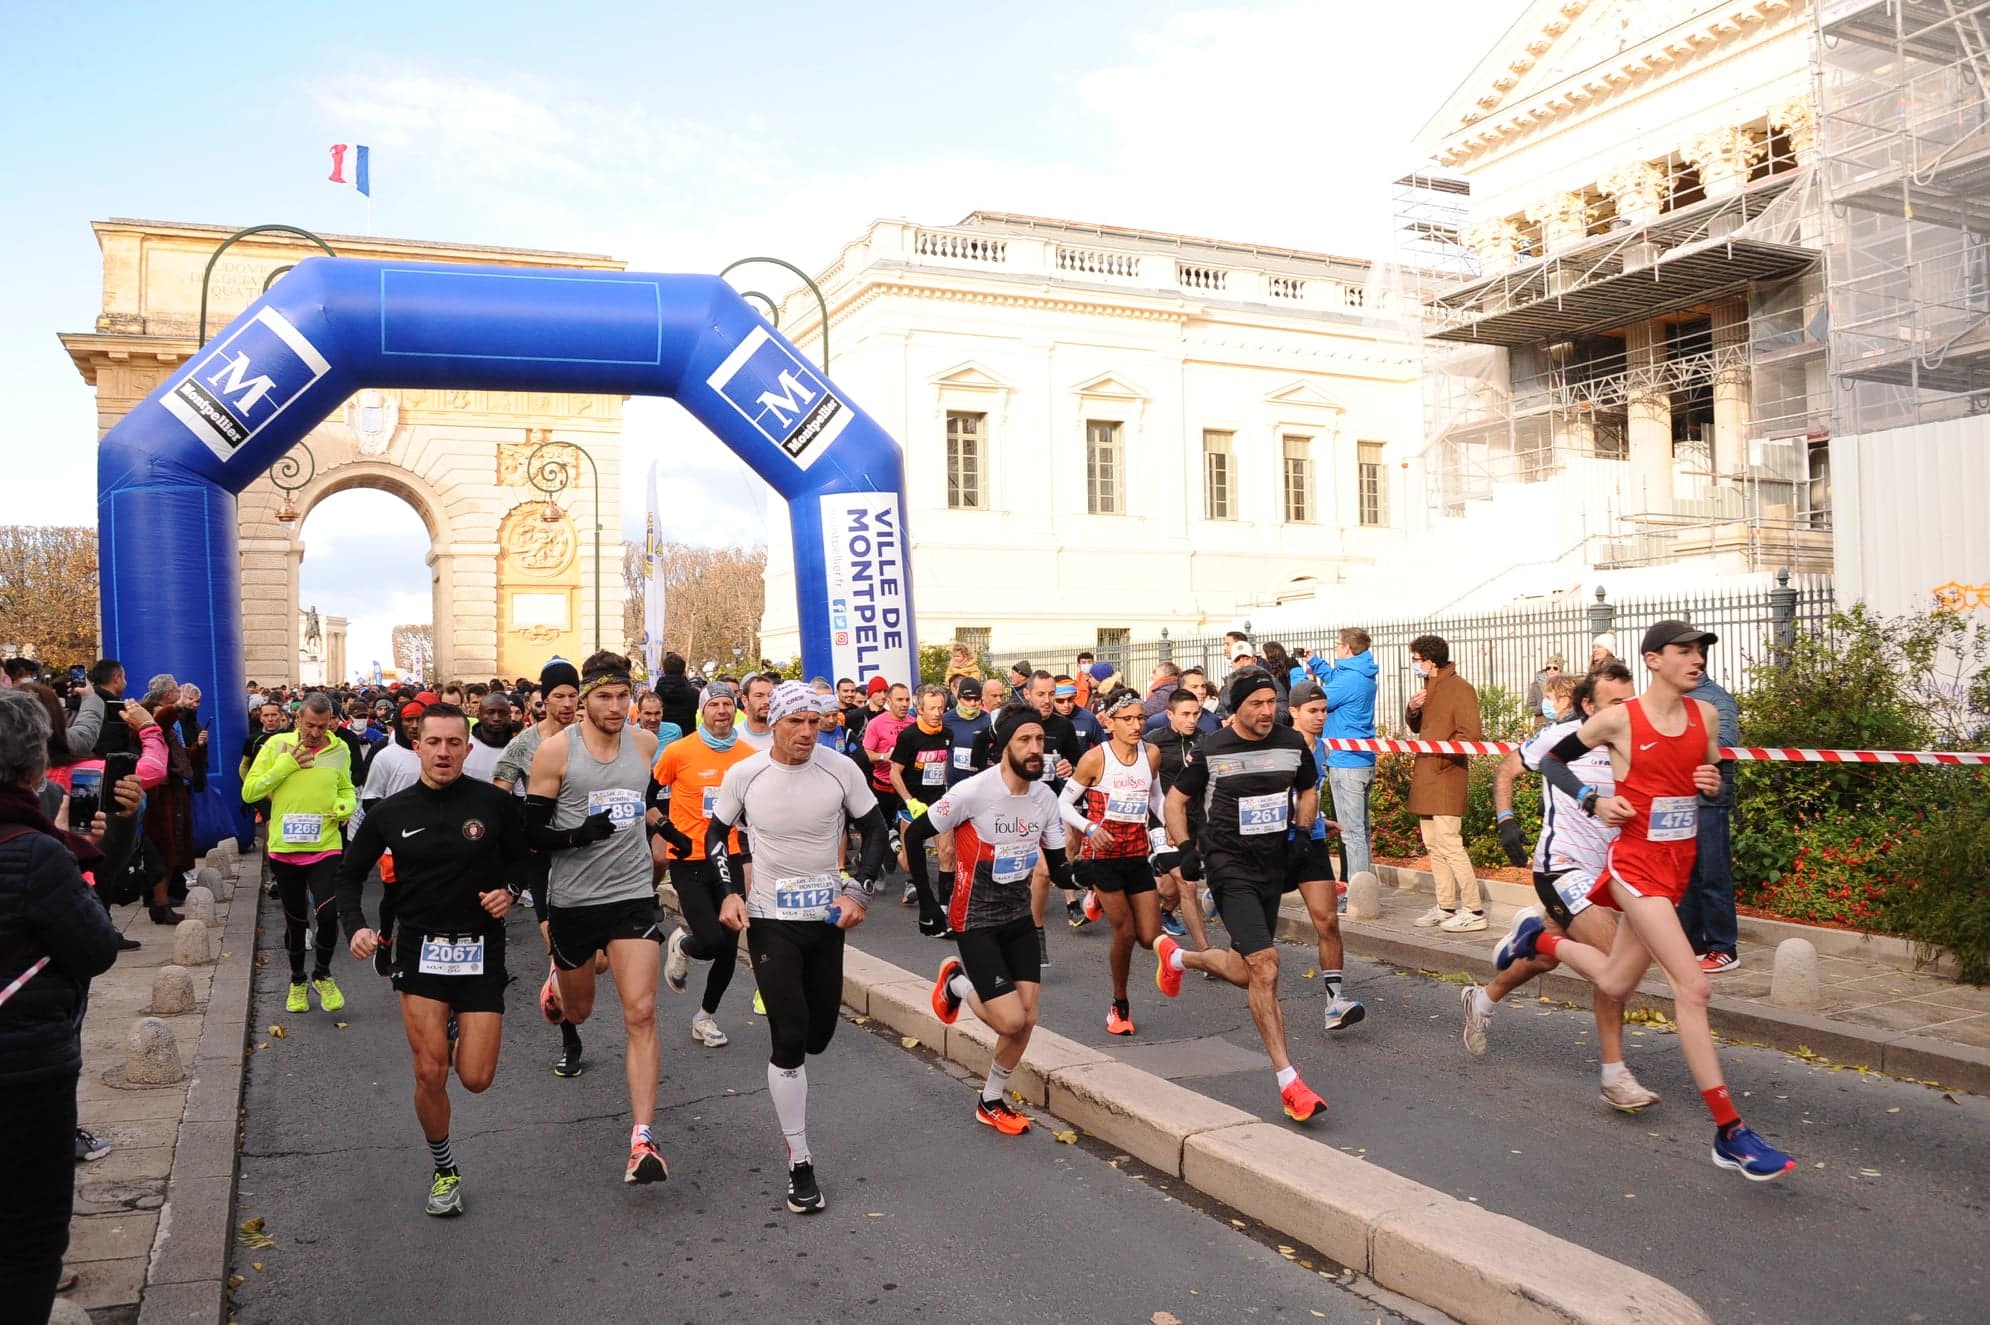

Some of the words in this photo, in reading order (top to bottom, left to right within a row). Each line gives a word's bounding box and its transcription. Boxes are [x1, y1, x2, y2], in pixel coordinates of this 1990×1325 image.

[207, 350, 277, 417] M
[755, 368, 817, 429] M
[179, 382, 242, 442] Montpellier
[787, 400, 838, 453] Montpellier
[875, 507, 899, 596] VILLE
[847, 508, 880, 690] MONTPELL
[882, 607, 902, 649] DE
[1117, 801, 1140, 813] 787
[1251, 808, 1280, 823] 261
[1661, 812, 1693, 828] 475
[287, 823, 319, 834] 1265
[782, 890, 830, 907] 1112
[427, 945, 478, 962] 2067
